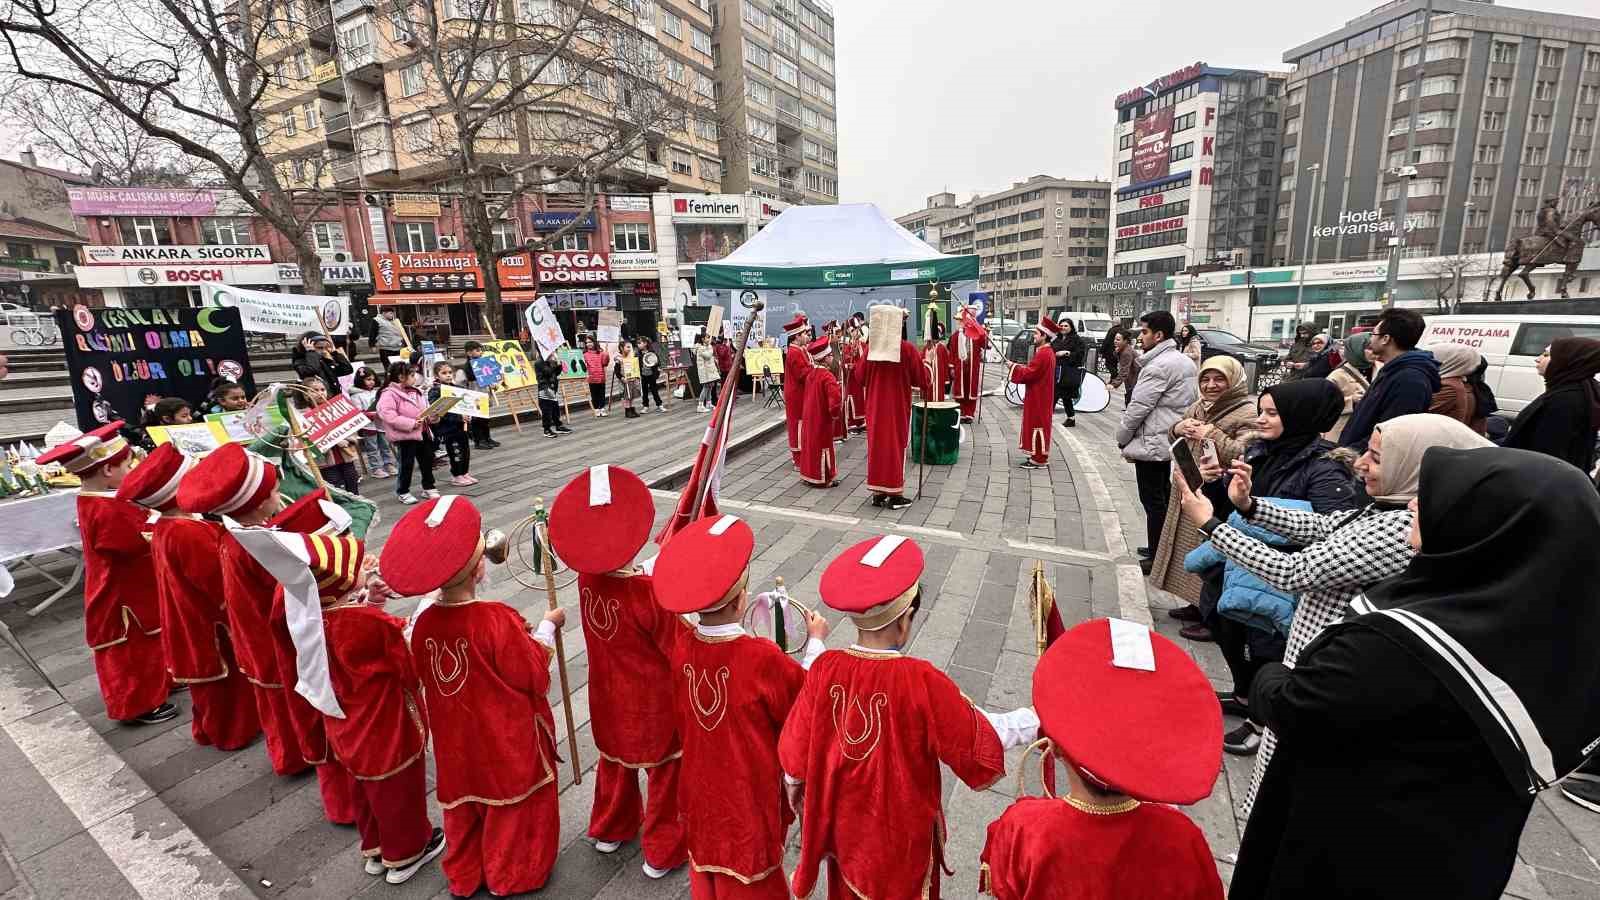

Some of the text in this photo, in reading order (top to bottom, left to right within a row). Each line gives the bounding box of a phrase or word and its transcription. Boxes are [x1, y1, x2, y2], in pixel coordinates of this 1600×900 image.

[688, 199, 740, 214] feminen
[1338, 207, 1382, 223] Hotel
[1312, 214, 1417, 238] kervansary
[122, 248, 192, 261] ANKARA
[199, 246, 265, 260] SİGORTA
[540, 253, 606, 268] GAGA
[165, 269, 224, 282] BOSCH
[320, 267, 364, 279] YHAN
[540, 267, 609, 282] DÖNER
[1431, 327, 1510, 337] KAN TOPLAMA
[145, 330, 206, 350] OLMA
